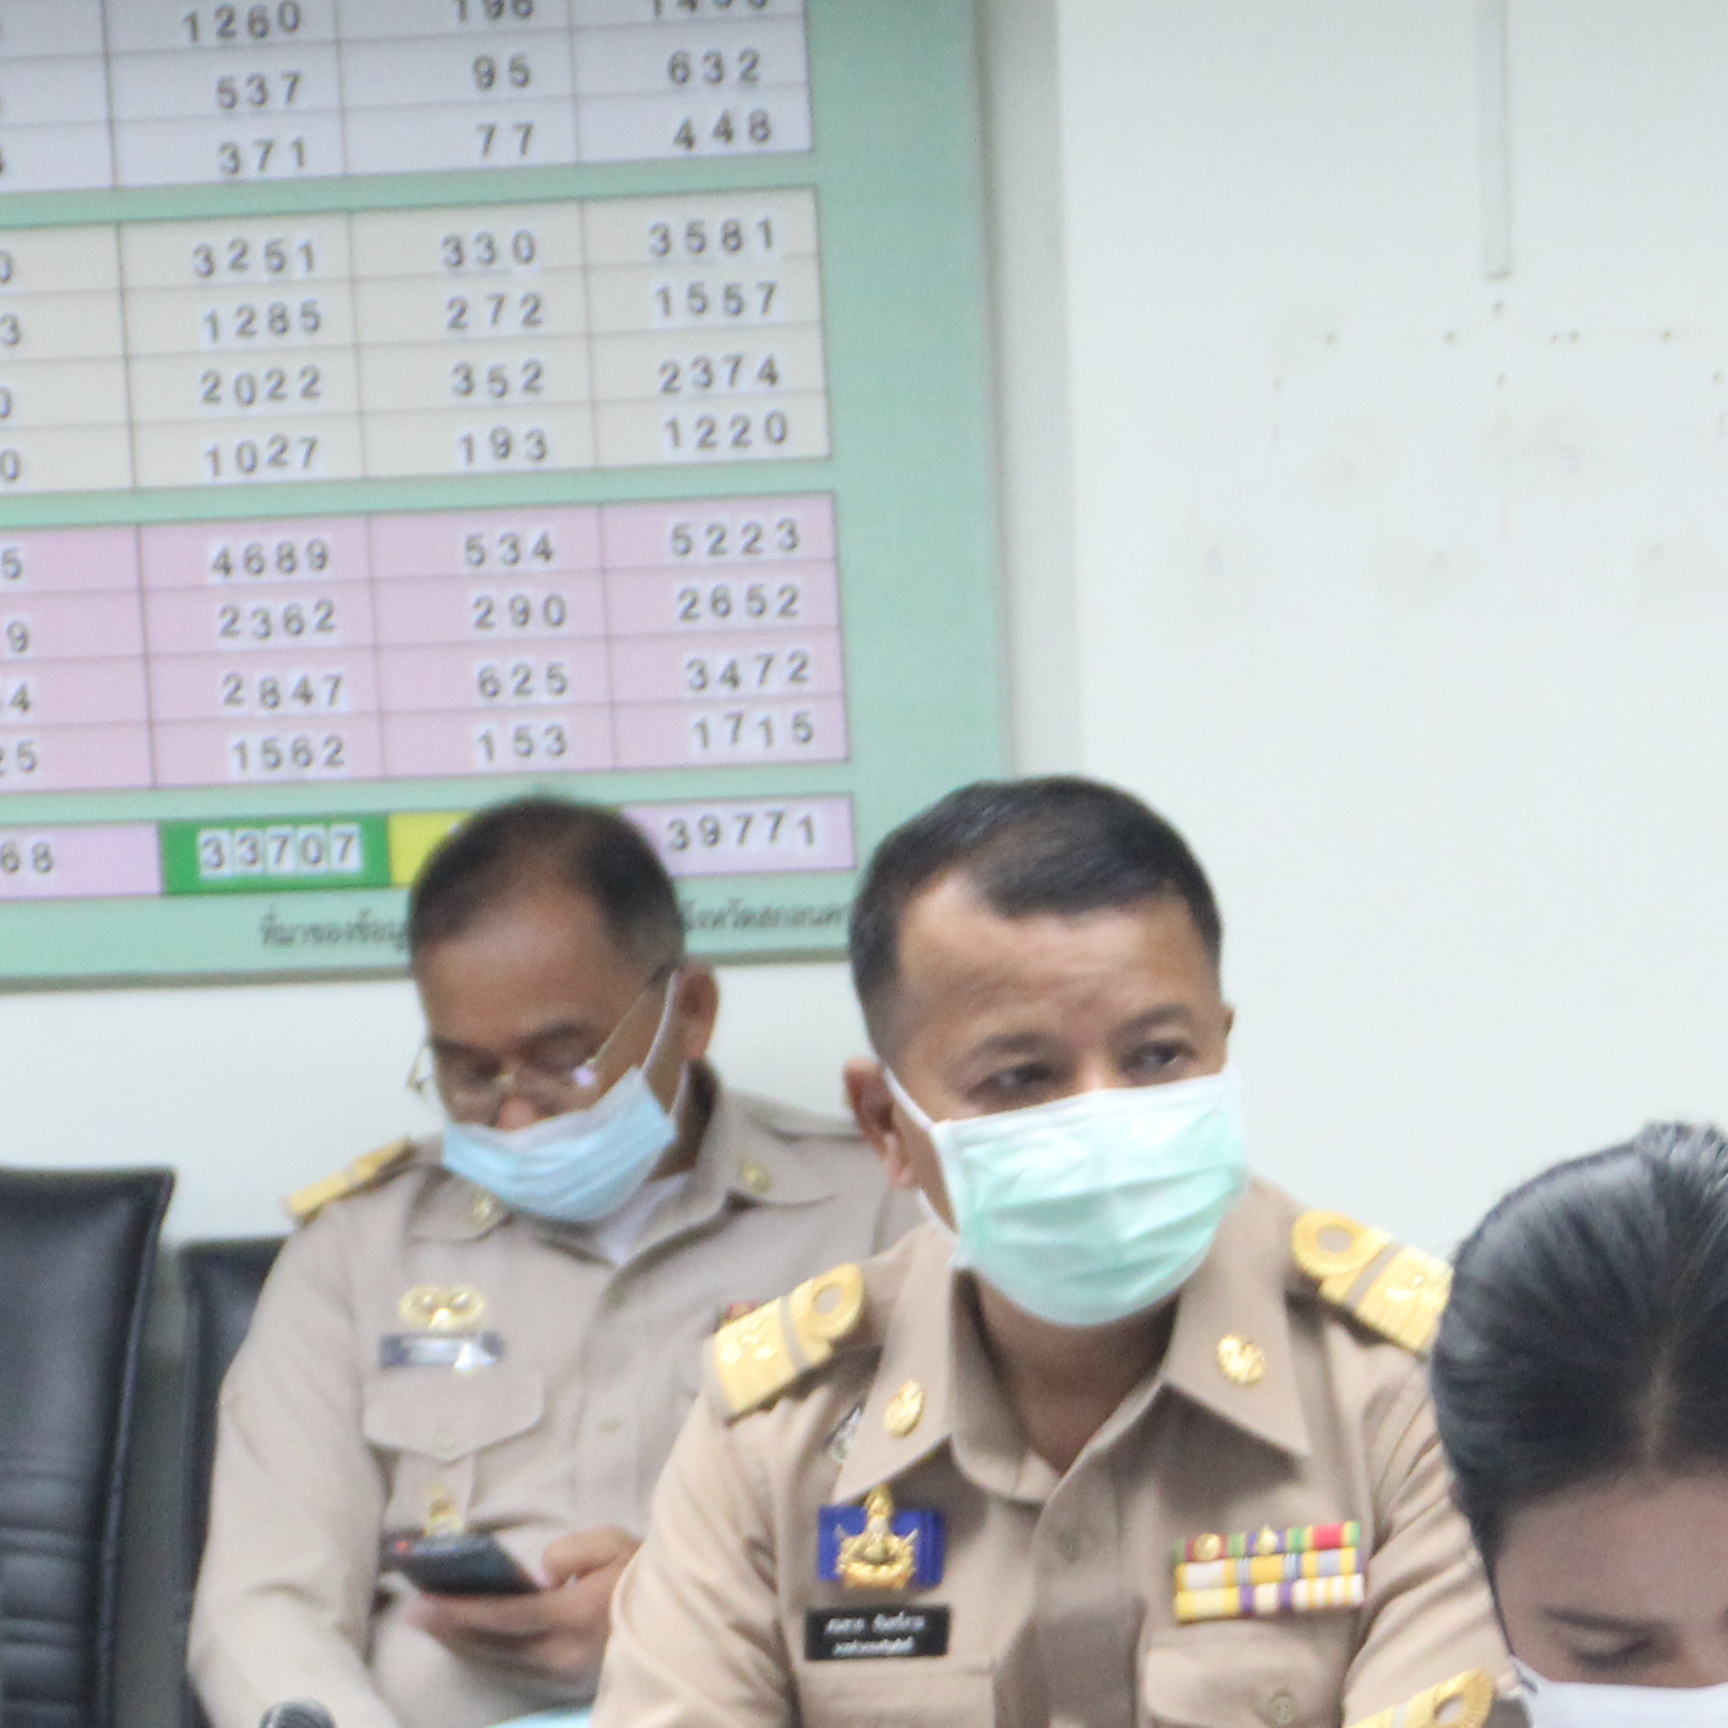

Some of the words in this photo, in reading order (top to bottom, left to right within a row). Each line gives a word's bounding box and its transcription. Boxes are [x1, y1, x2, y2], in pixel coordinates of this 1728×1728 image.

[216, 70, 302, 112] 537
[472, 54, 532, 91] 95
[667, 48, 761, 87] 632
[218, 137, 308, 176] 371
[477, 121, 535, 157] 77
[674, 110, 773, 152] 448
[193, 238, 315, 280] 3251
[442, 231, 537, 273] 330
[650, 218, 773, 259] 3581
[0, 314, 23, 349] 3
[205, 300, 323, 342] 1285
[446, 292, 543, 332] 272
[657, 281, 778, 319] 1557
[201, 365, 321, 408] 2022
[452, 360, 544, 400] 352
[659, 353, 780, 396] 2374
[206, 433, 319, 477] 1027
[461, 426, 549, 465] 193
[665, 410, 790, 451] 1220
[211, 540, 330, 578] 4689
[464, 533, 555, 569] 534
[671, 518, 801, 558] 5223
[6, 622, 31, 654] 9
[219, 598, 336, 641] 2362
[473, 593, 568, 631] 290
[678, 585, 800, 623] 2652
[223, 672, 343, 711] 2847
[476, 663, 569, 701] 625
[686, 650, 810, 693] 3472
[234, 734, 345, 772] 1562
[479, 724, 569, 762] 153
[694, 710, 816, 750] 1715
[202, 830, 357, 870] 33707
[668, 816, 816, 852] 39771
